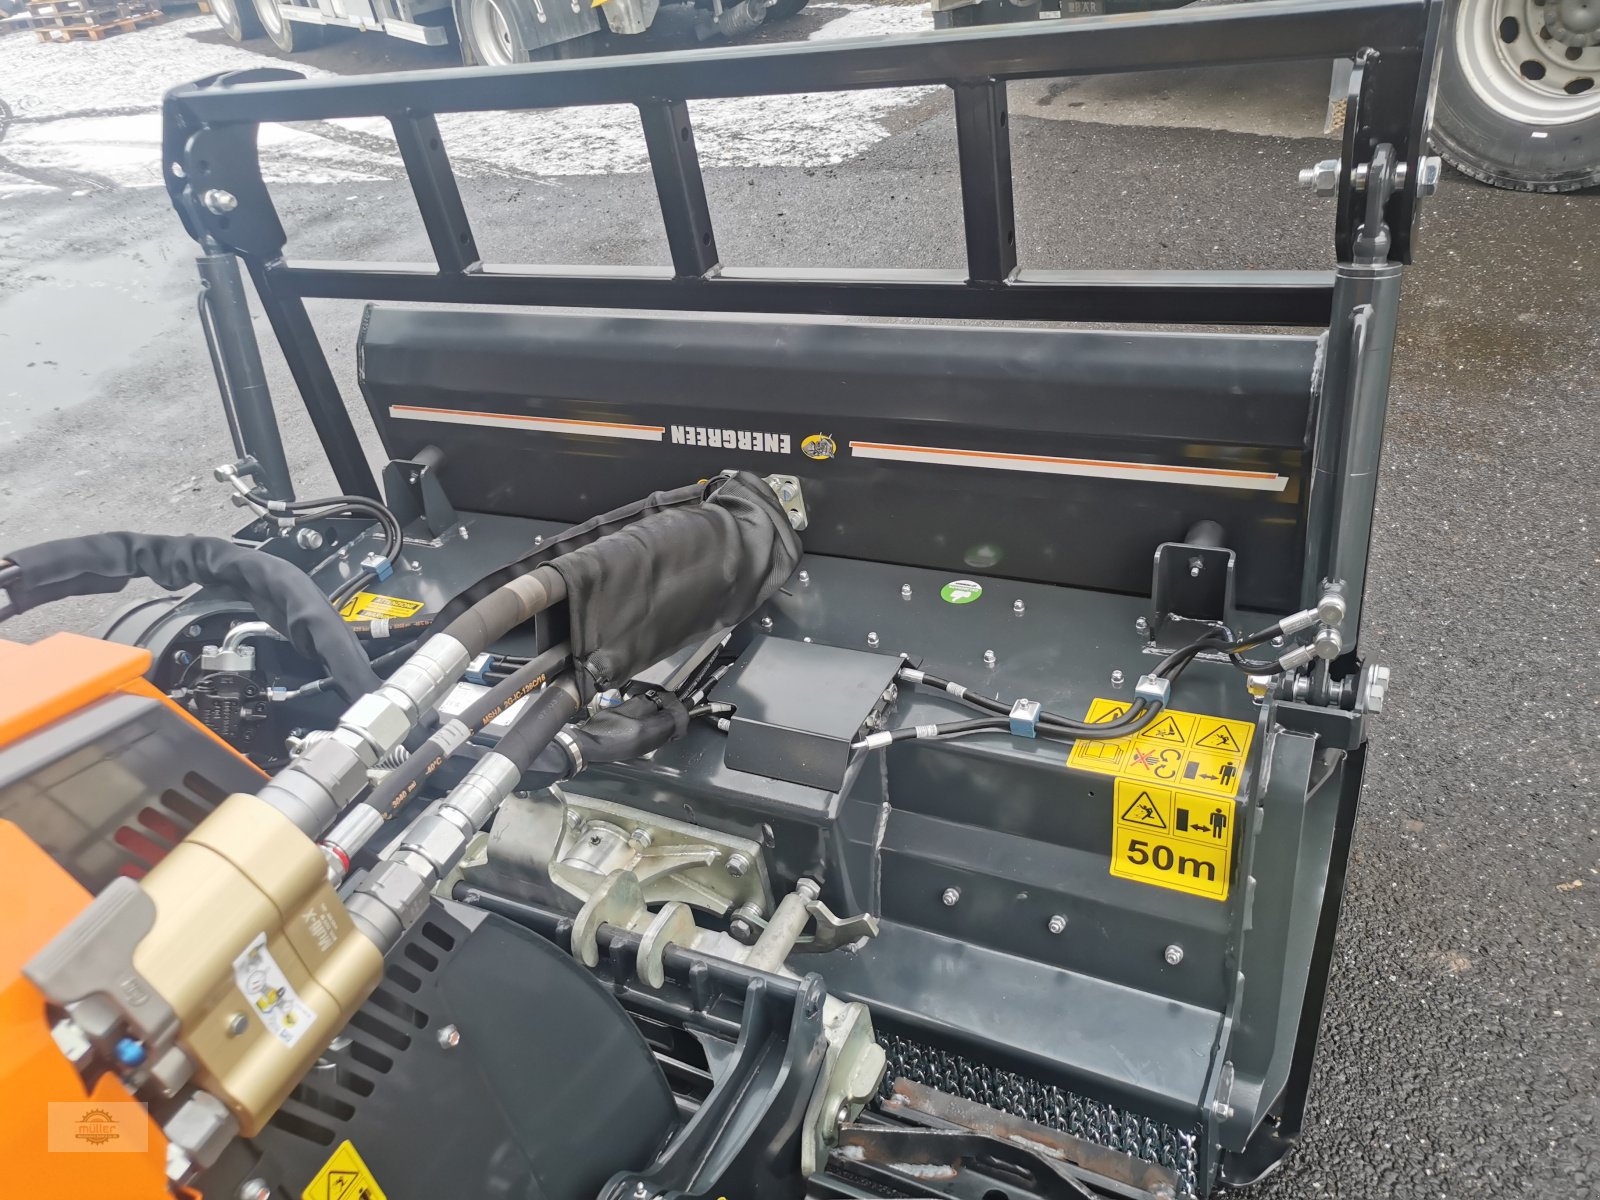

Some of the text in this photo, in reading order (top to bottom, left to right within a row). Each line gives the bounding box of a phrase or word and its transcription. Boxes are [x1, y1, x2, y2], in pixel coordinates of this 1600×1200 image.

[671, 425, 791, 454] ENERGREEN
[482, 706, 502, 726] MSHA
[1127, 839, 1216, 882] 50m
